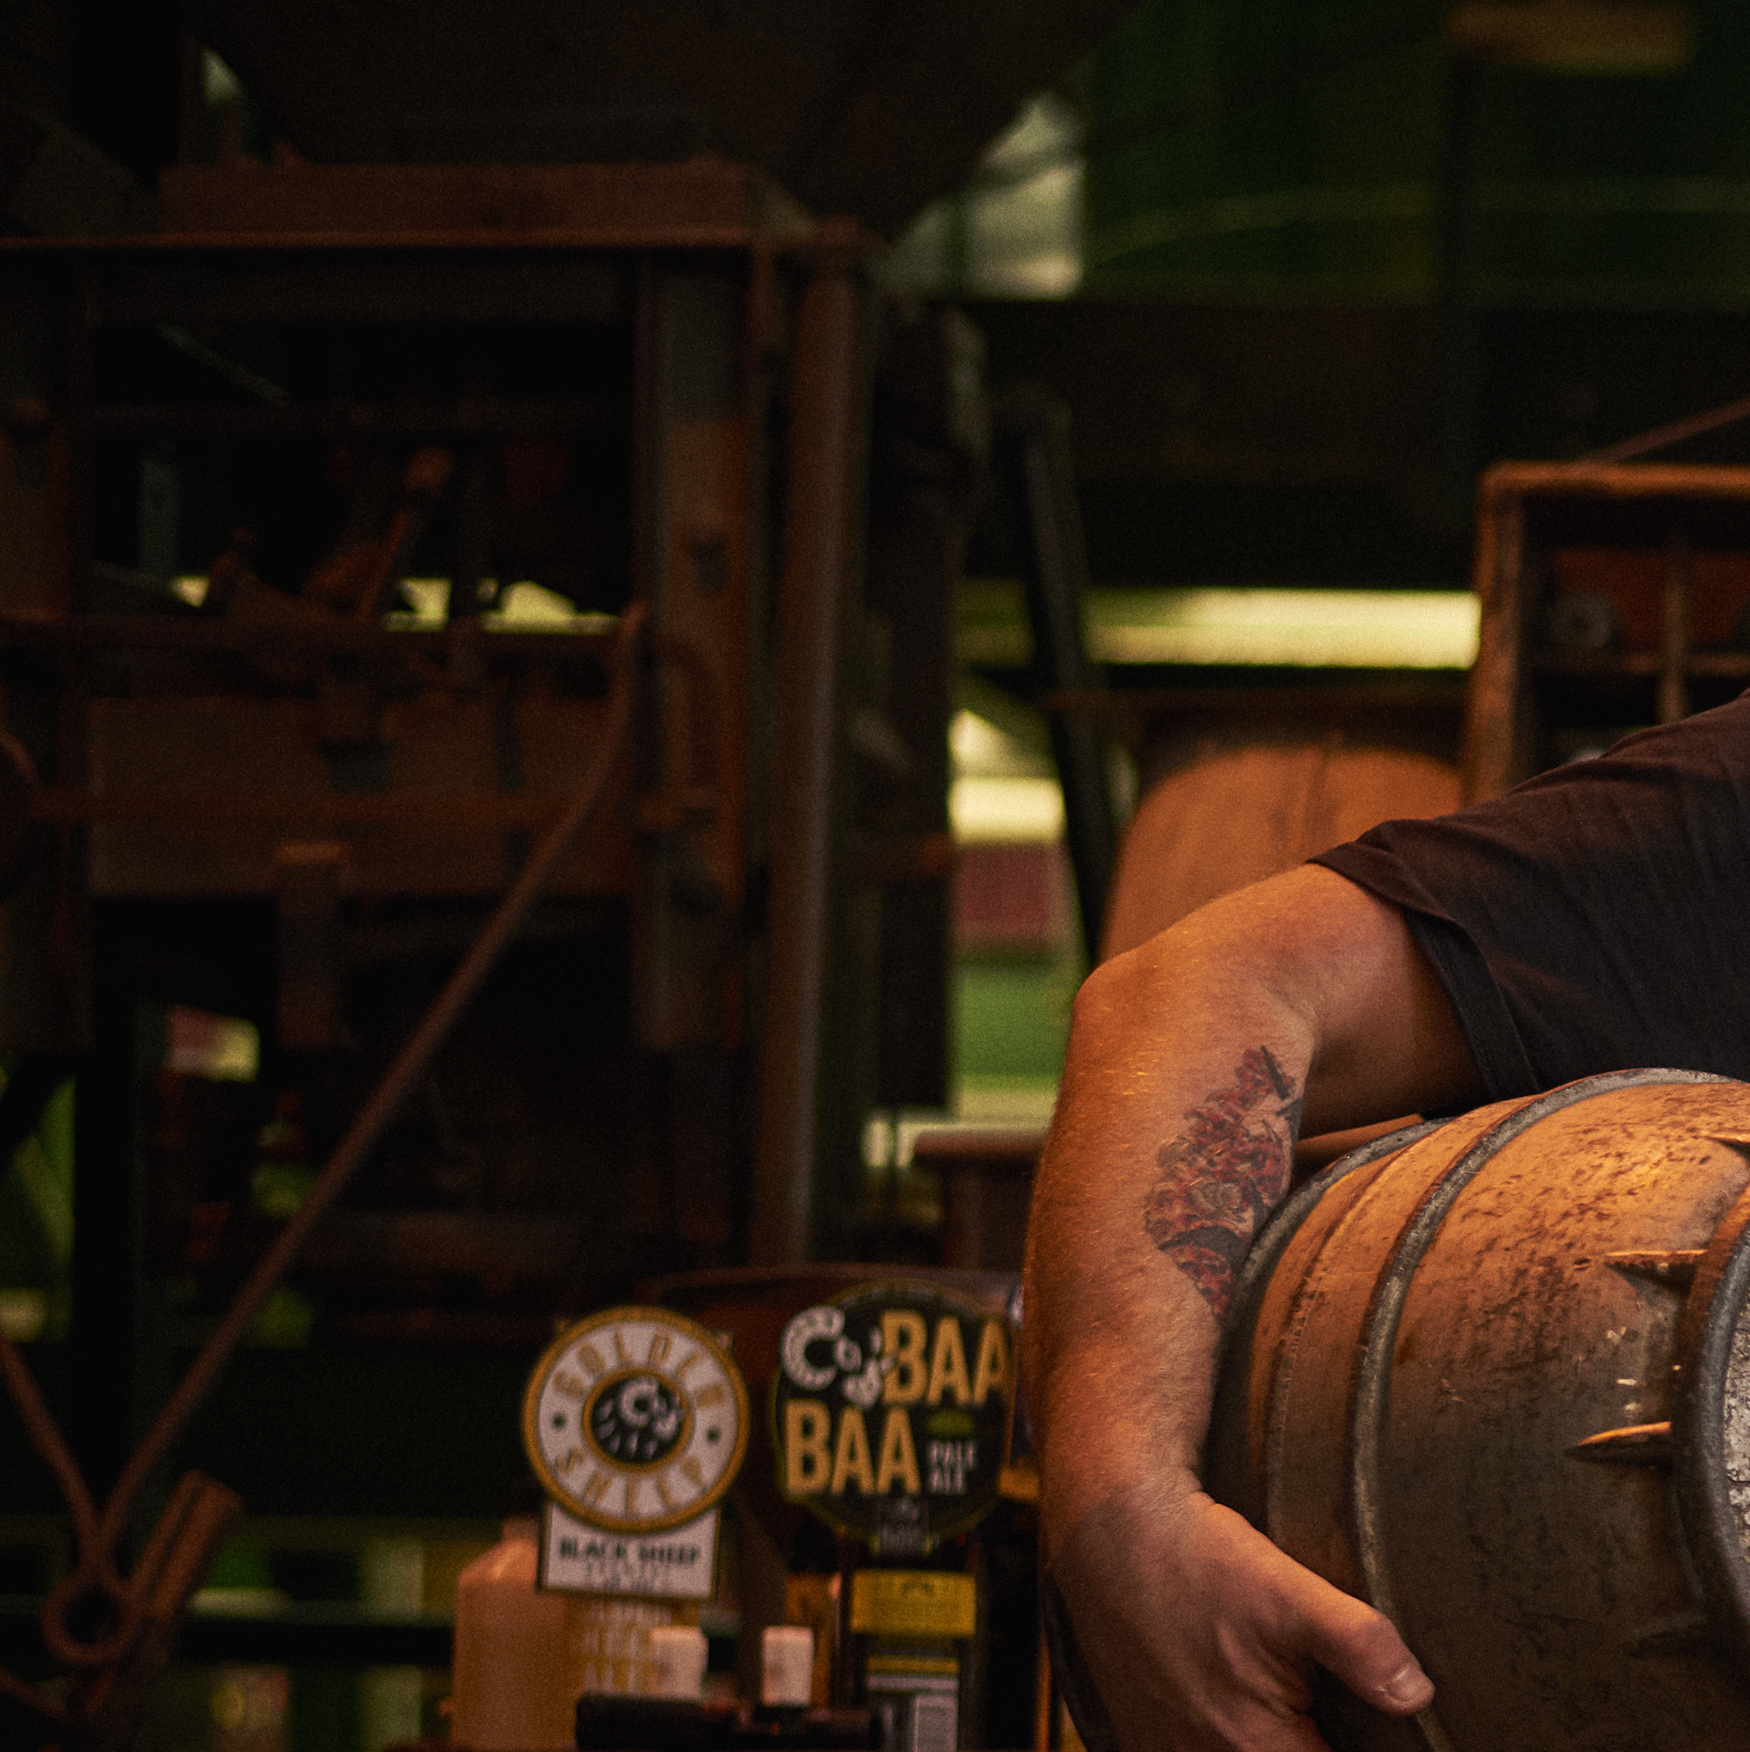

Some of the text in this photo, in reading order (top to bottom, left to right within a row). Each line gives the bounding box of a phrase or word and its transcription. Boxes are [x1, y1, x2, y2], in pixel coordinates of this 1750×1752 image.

[553, 1330, 726, 1406] GOLDEN
[878, 1307, 1010, 1407] BAA
[782, 1398, 923, 1498] BAA
[928, 1438, 978, 1471] PALE
[927, 1466, 967, 1497] ALE
[558, 1537, 701, 1567] BLACK SHEEP
